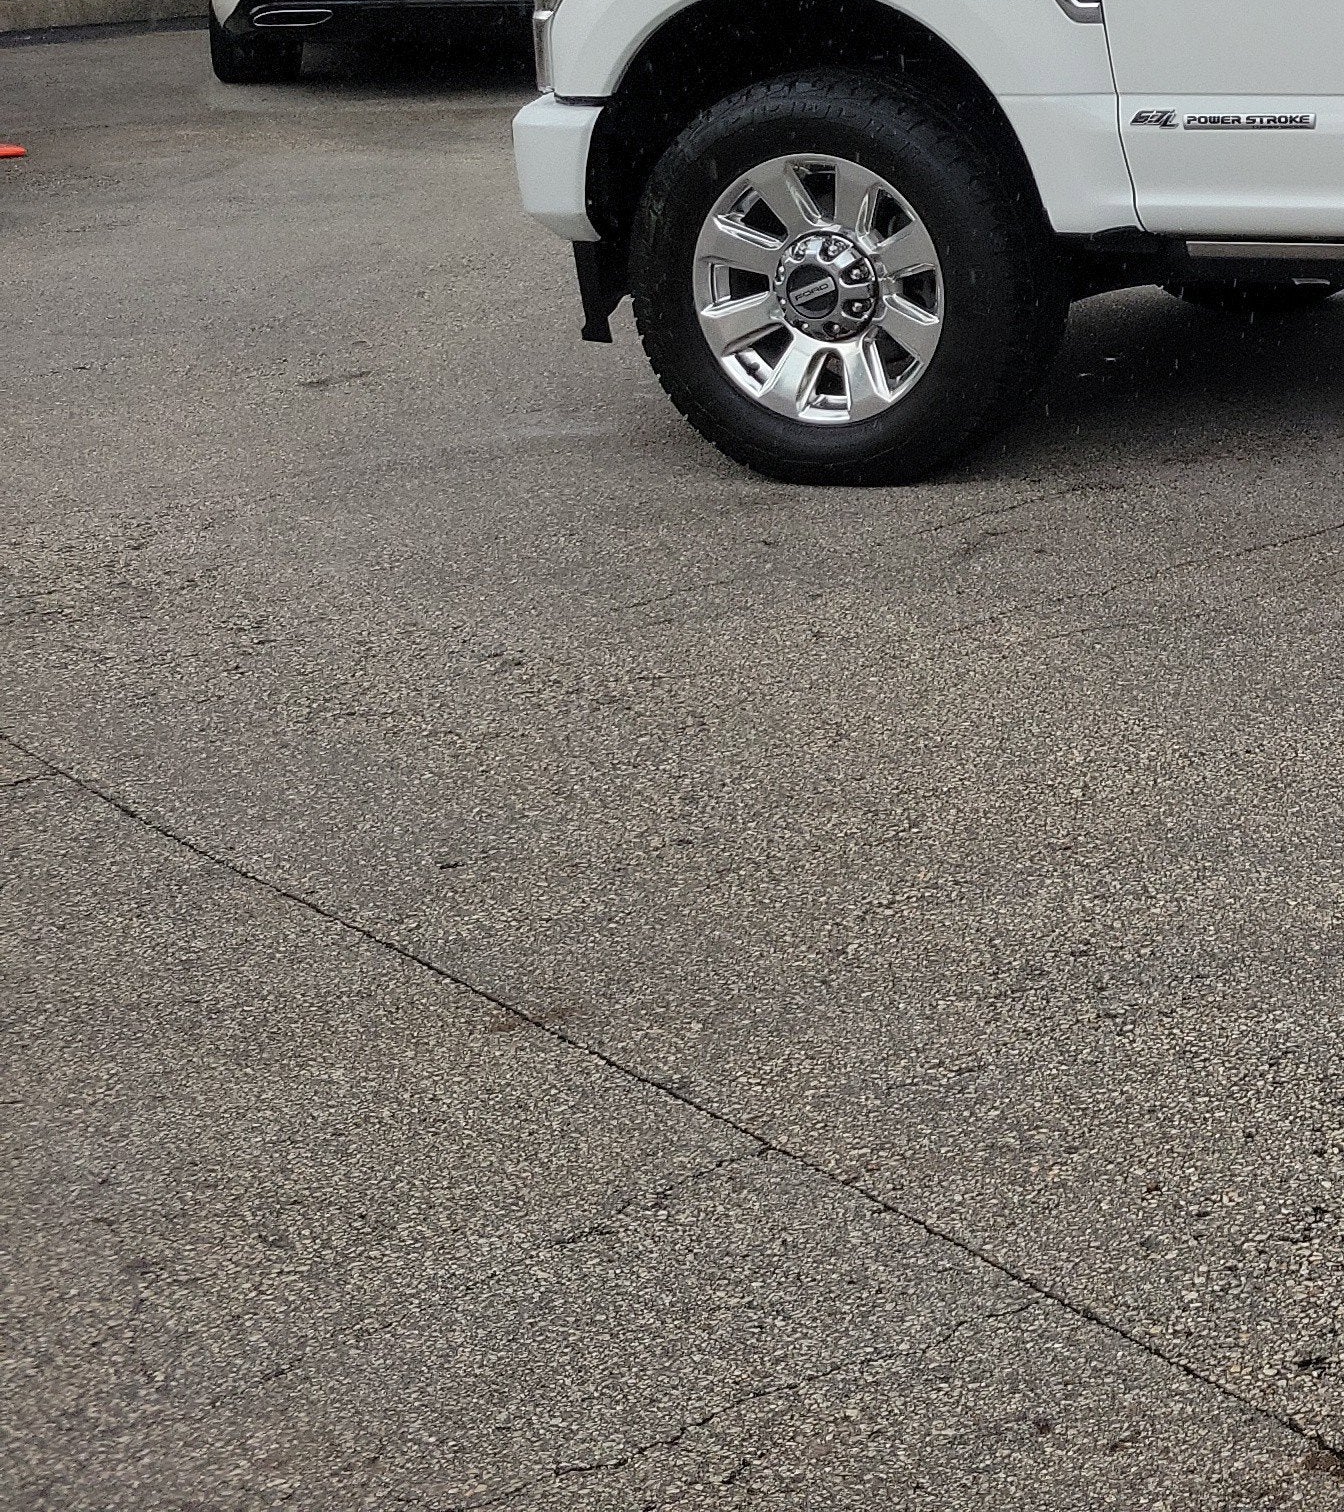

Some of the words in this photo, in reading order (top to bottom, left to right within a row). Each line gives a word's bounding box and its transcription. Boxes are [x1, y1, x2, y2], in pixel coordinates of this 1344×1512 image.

[1186, 115, 1242, 125] POWER
[1245, 114, 1311, 125] STROKE
[795, 283, 829, 301] FORD
